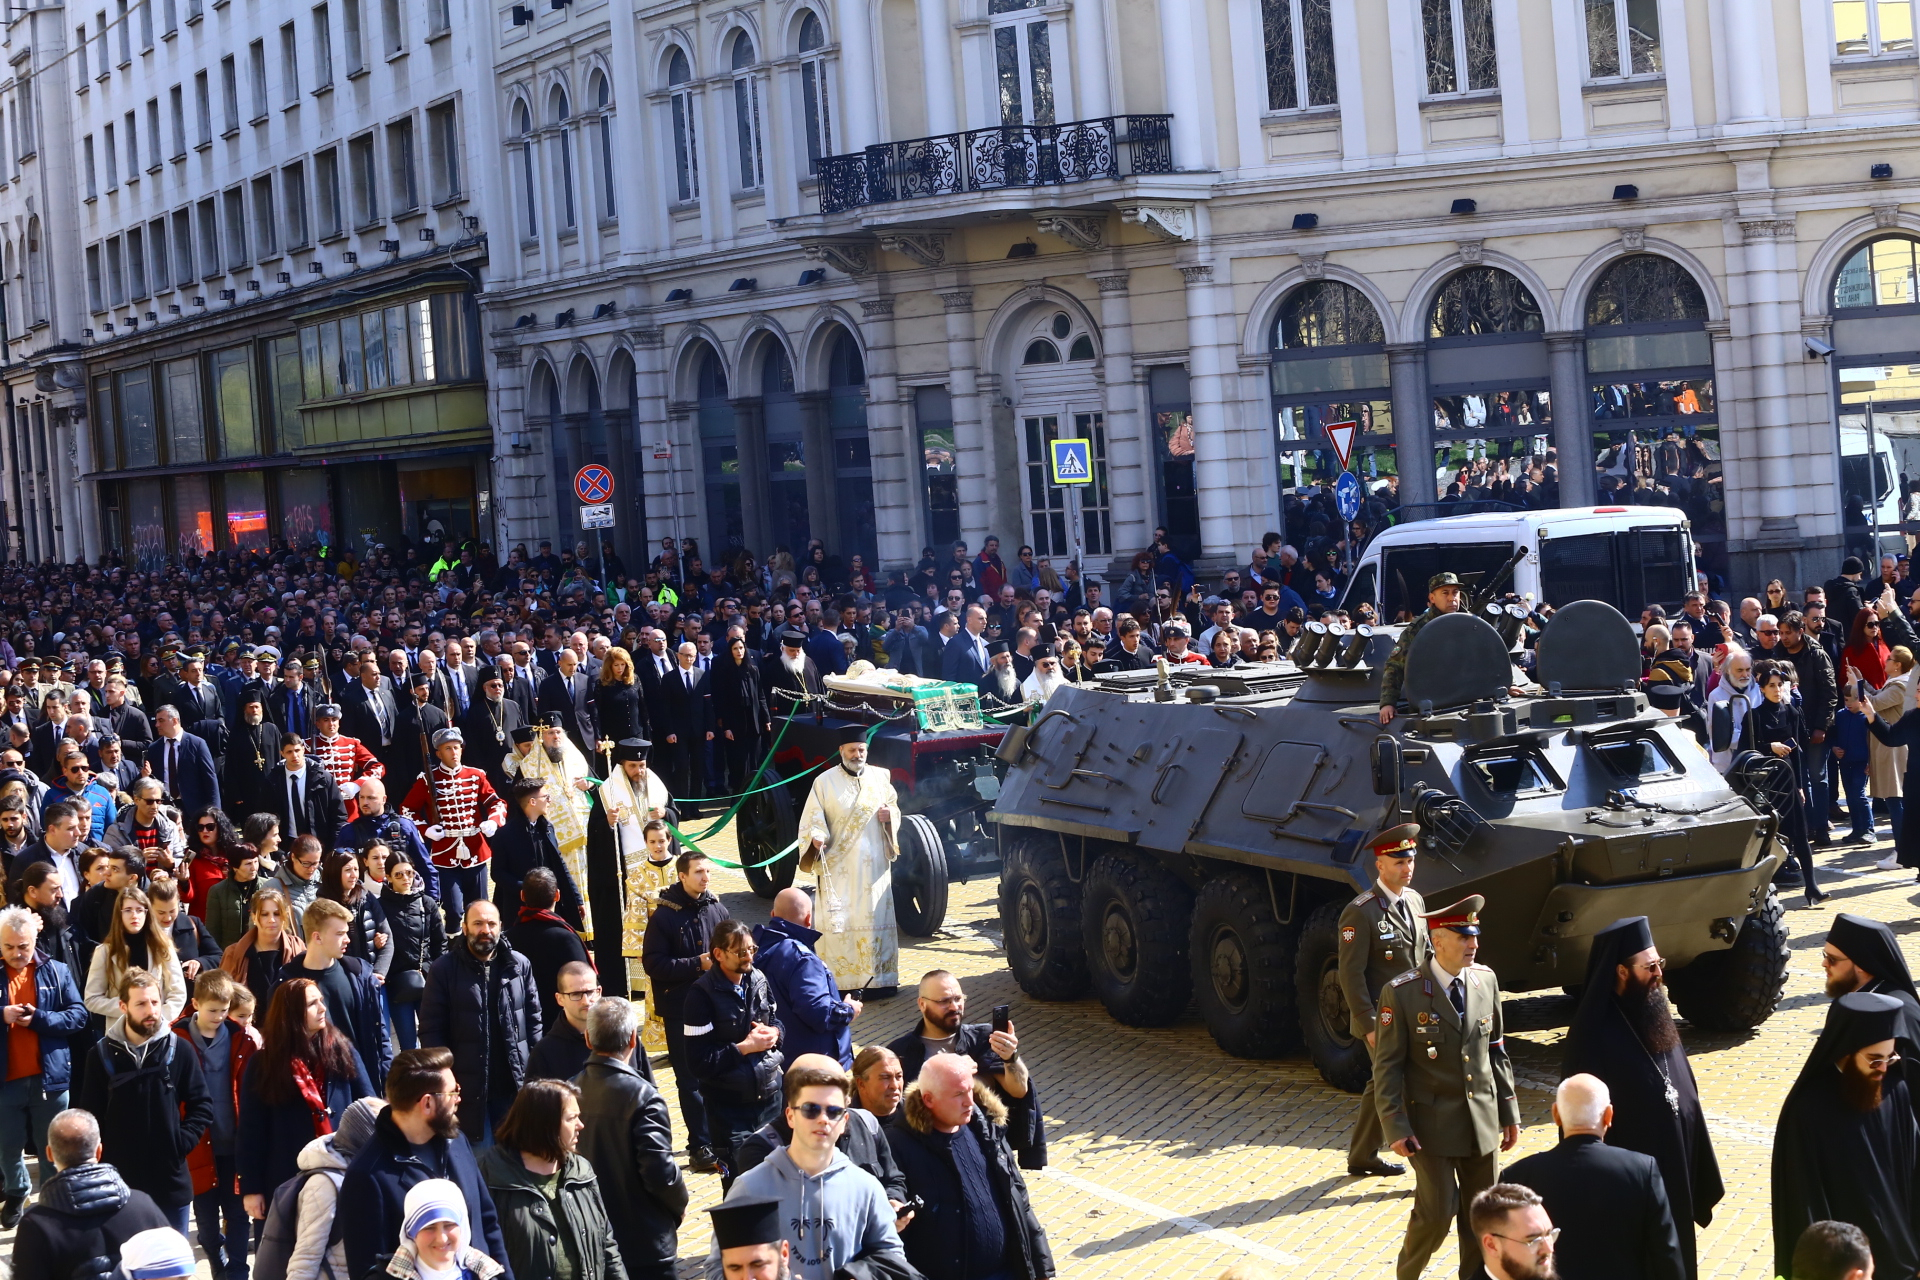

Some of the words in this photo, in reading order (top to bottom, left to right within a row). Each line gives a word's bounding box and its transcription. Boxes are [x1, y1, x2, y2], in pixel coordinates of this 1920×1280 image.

[1650, 782, 1695, 796] 001577
[791, 1245, 806, 1264] REAL
[822, 1245, 833, 1262] JUST
[807, 1258, 821, 1266] GOT
